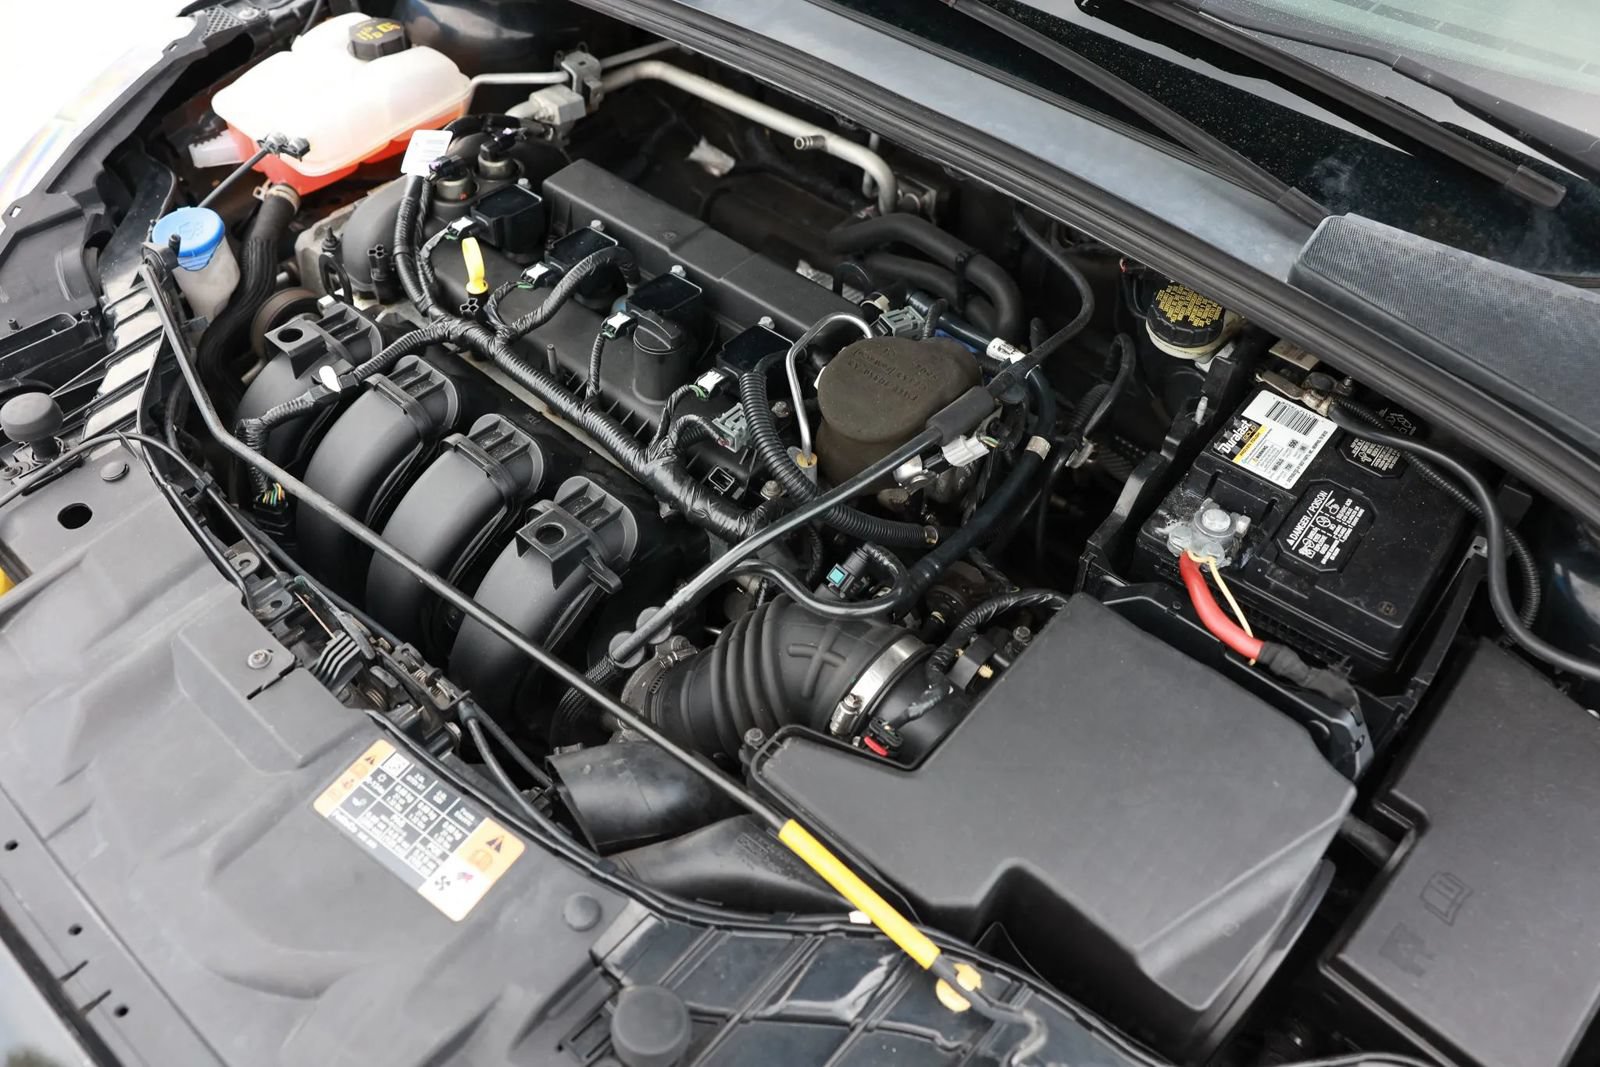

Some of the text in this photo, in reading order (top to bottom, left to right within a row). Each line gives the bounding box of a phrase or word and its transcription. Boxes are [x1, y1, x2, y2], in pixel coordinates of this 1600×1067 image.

[1217, 419, 1252, 454] Duralast
[1243, 425, 1257, 441] GOLD
[1289, 515, 1311, 541] DANGER
[1308, 490, 1328, 513] POISON
